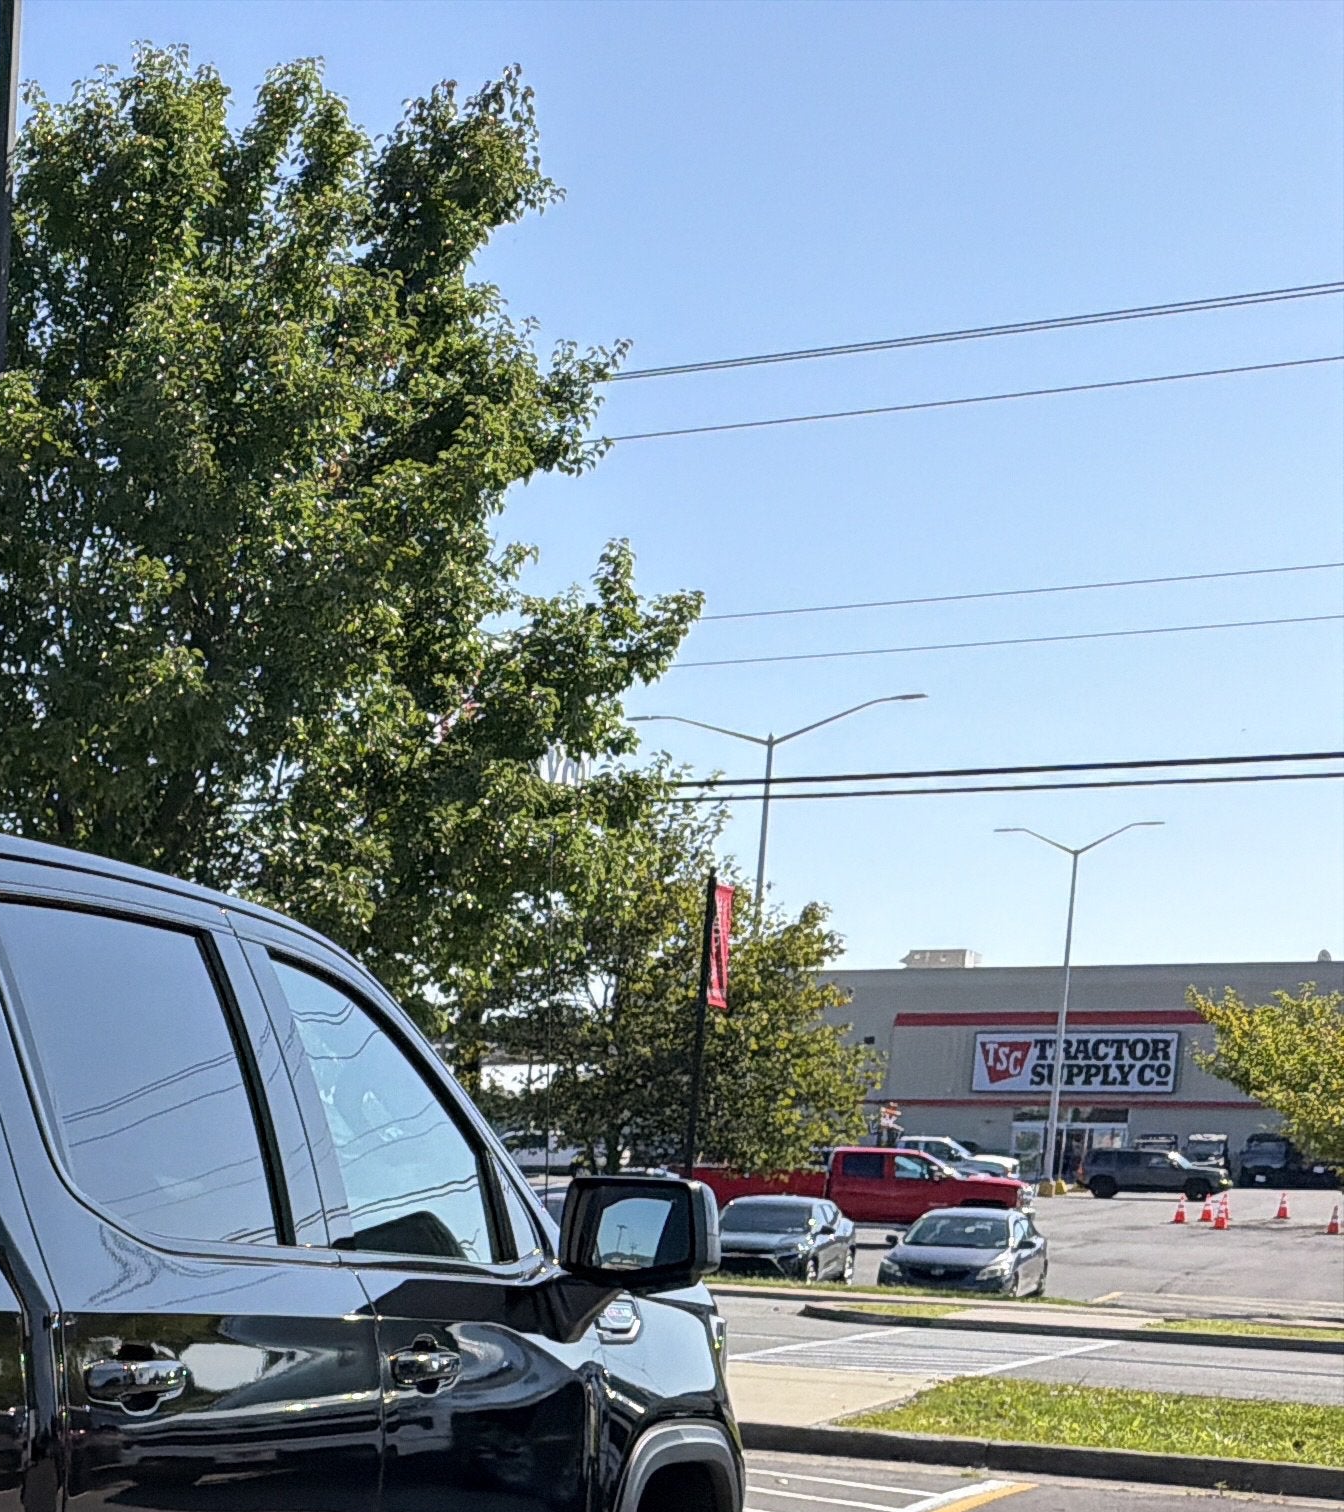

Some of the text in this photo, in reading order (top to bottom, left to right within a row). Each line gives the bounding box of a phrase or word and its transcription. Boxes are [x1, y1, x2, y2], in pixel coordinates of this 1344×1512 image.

[985, 1042, 1023, 1076] TSC
[1034, 1039, 1172, 1062] TRACTOR
[1029, 1062, 1136, 1087] SUPPLY
